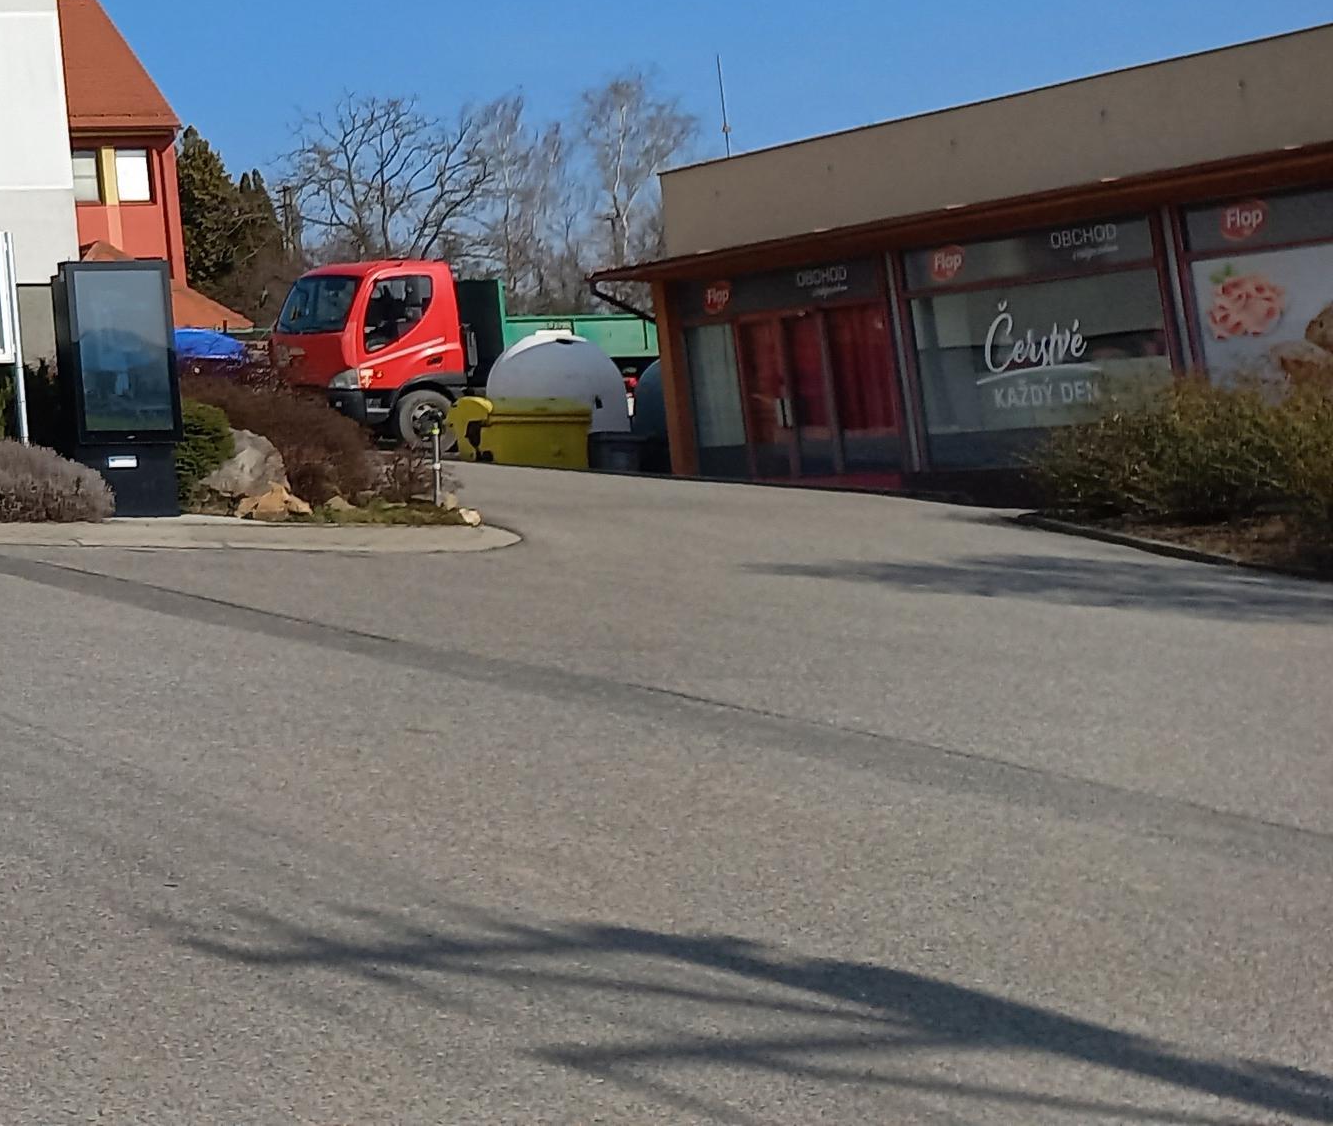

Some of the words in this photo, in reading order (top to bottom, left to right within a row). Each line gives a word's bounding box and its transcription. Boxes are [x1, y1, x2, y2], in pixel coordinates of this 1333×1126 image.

[1226, 207, 1263, 229] Flop
[1050, 223, 1118, 250] OBCHOD
[934, 253, 962, 272] Flop
[796, 265, 848, 287] OBCHOD
[707, 287, 729, 305] Flop
[985, 299, 1088, 374] Čerstvé
[994, 377, 1054, 409] KAŽDÝ
